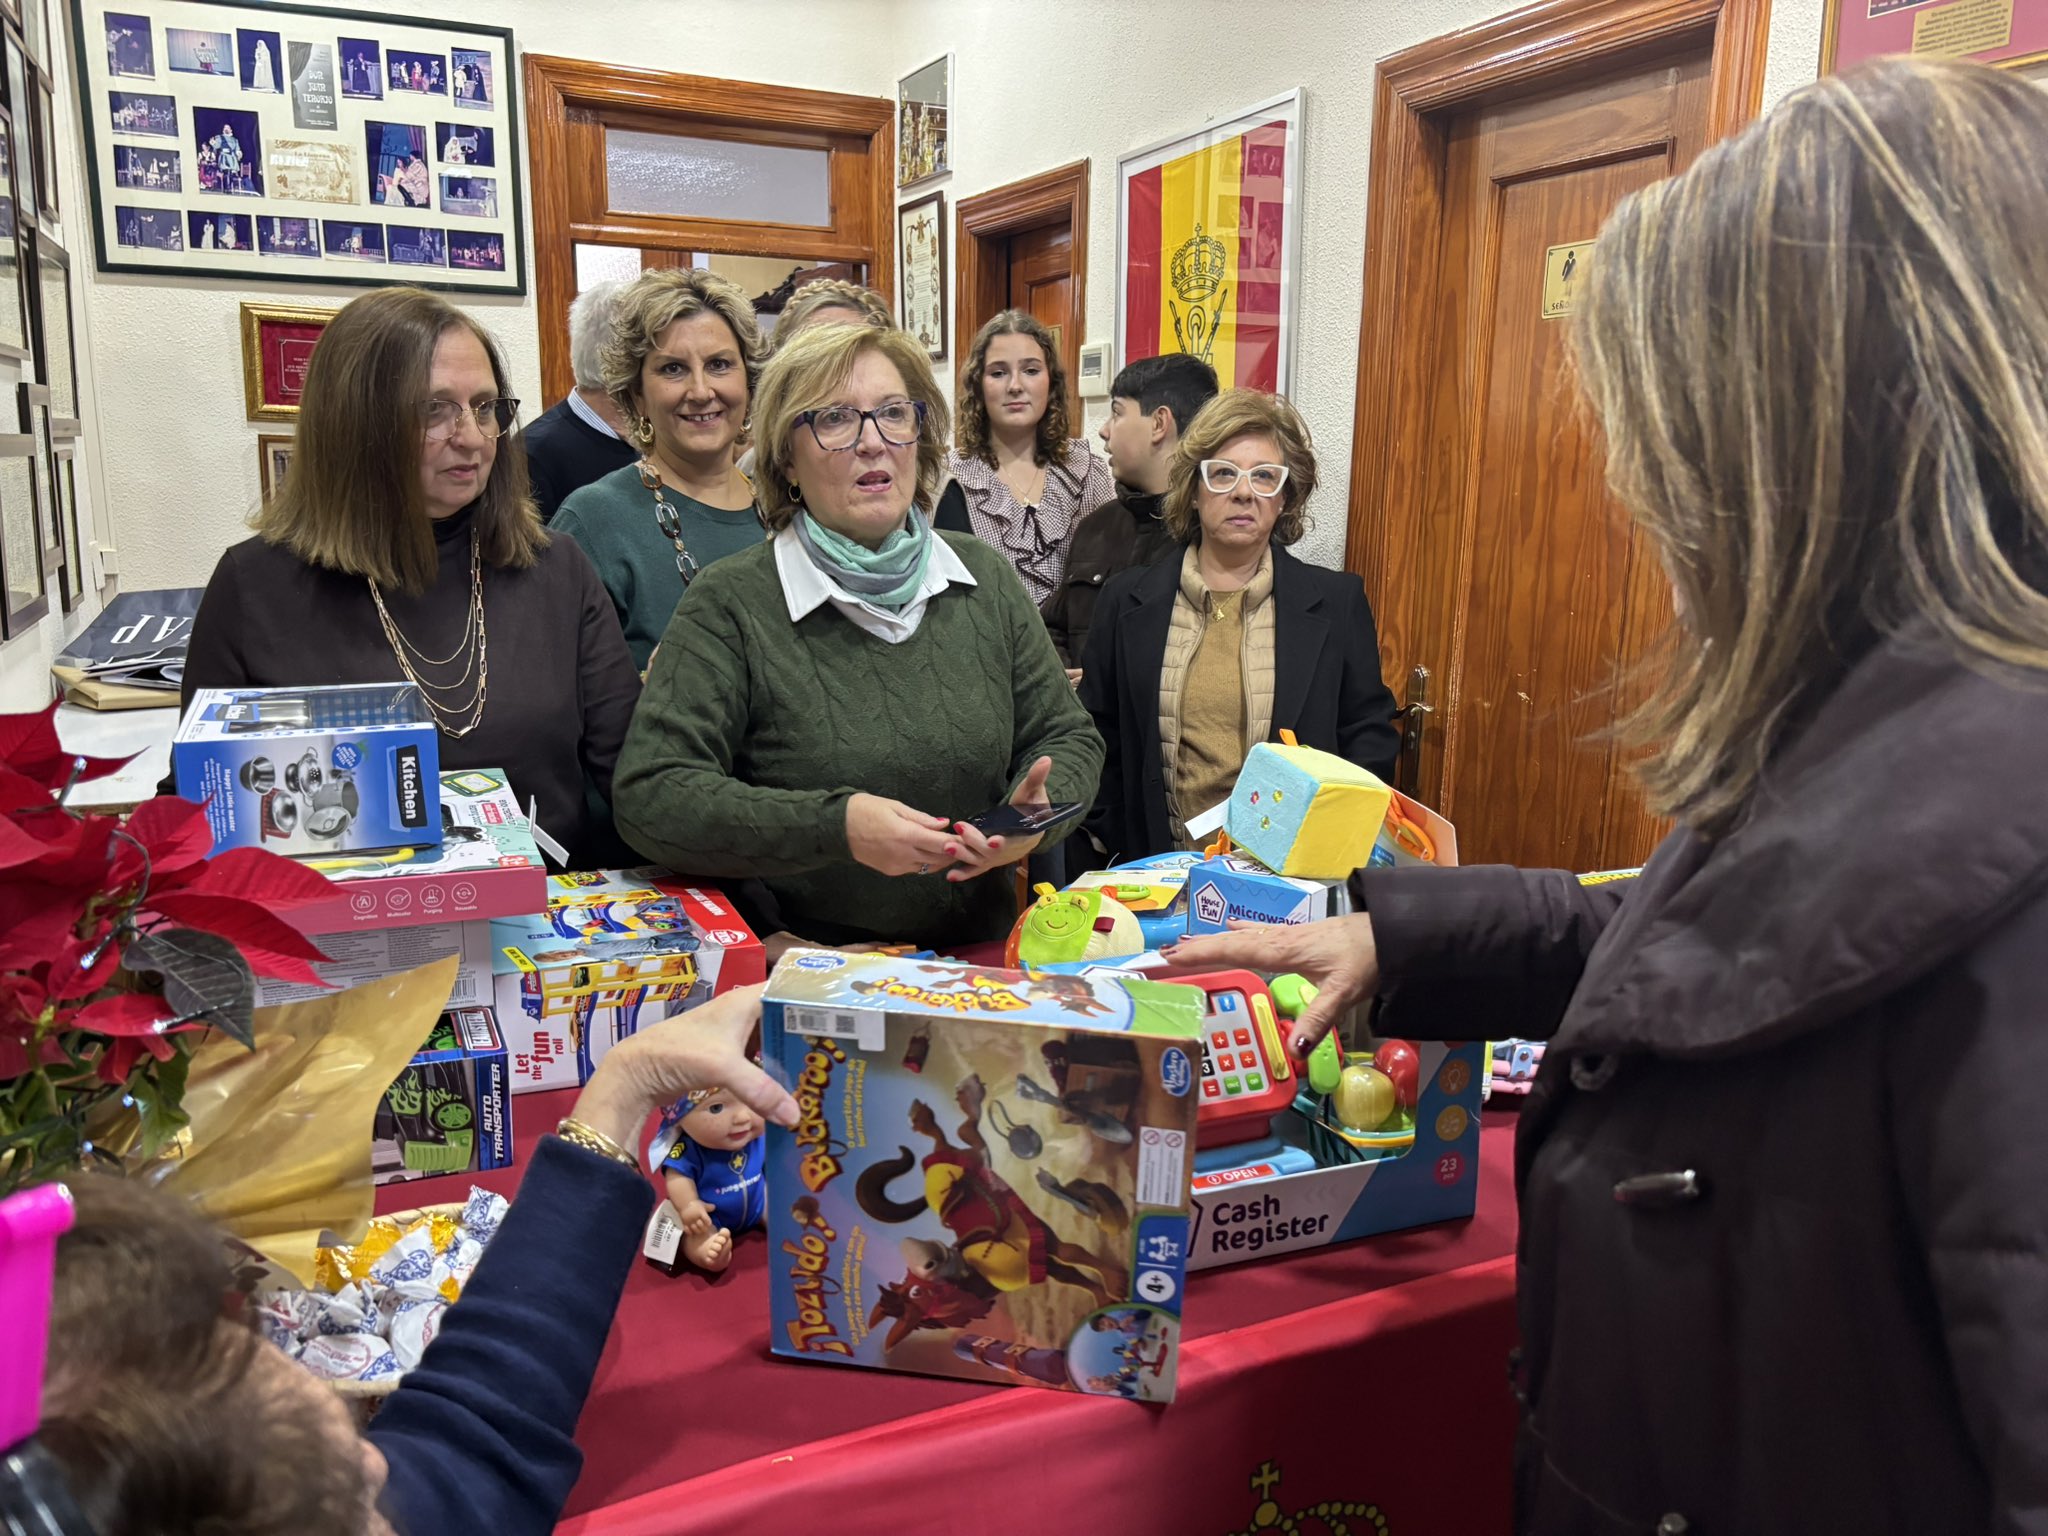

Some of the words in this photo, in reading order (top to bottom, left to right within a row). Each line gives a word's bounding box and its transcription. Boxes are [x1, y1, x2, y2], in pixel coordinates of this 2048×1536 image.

[110, 614, 192, 644] AP
[224, 769, 232, 790] Happy
[401, 755, 417, 820] Kitchen
[1201, 904, 1218, 918] FUN
[531, 1031, 555, 1064] fun
[555, 1037, 564, 1055] roll
[515, 1052, 530, 1074] Let
[532, 1064, 543, 1081] the
[1202, 1062, 1210, 1073] 3
[483, 1094, 493, 1132] AUTO
[491, 1063, 504, 1160] TRANSPORTER
[1223, 1168, 1260, 1182] OPEN
[1440, 1158, 1458, 1173] 23
[1212, 1194, 1280, 1226] Cash
[1212, 1214, 1329, 1254] Register
[1146, 1275, 1165, 1294] 4+
